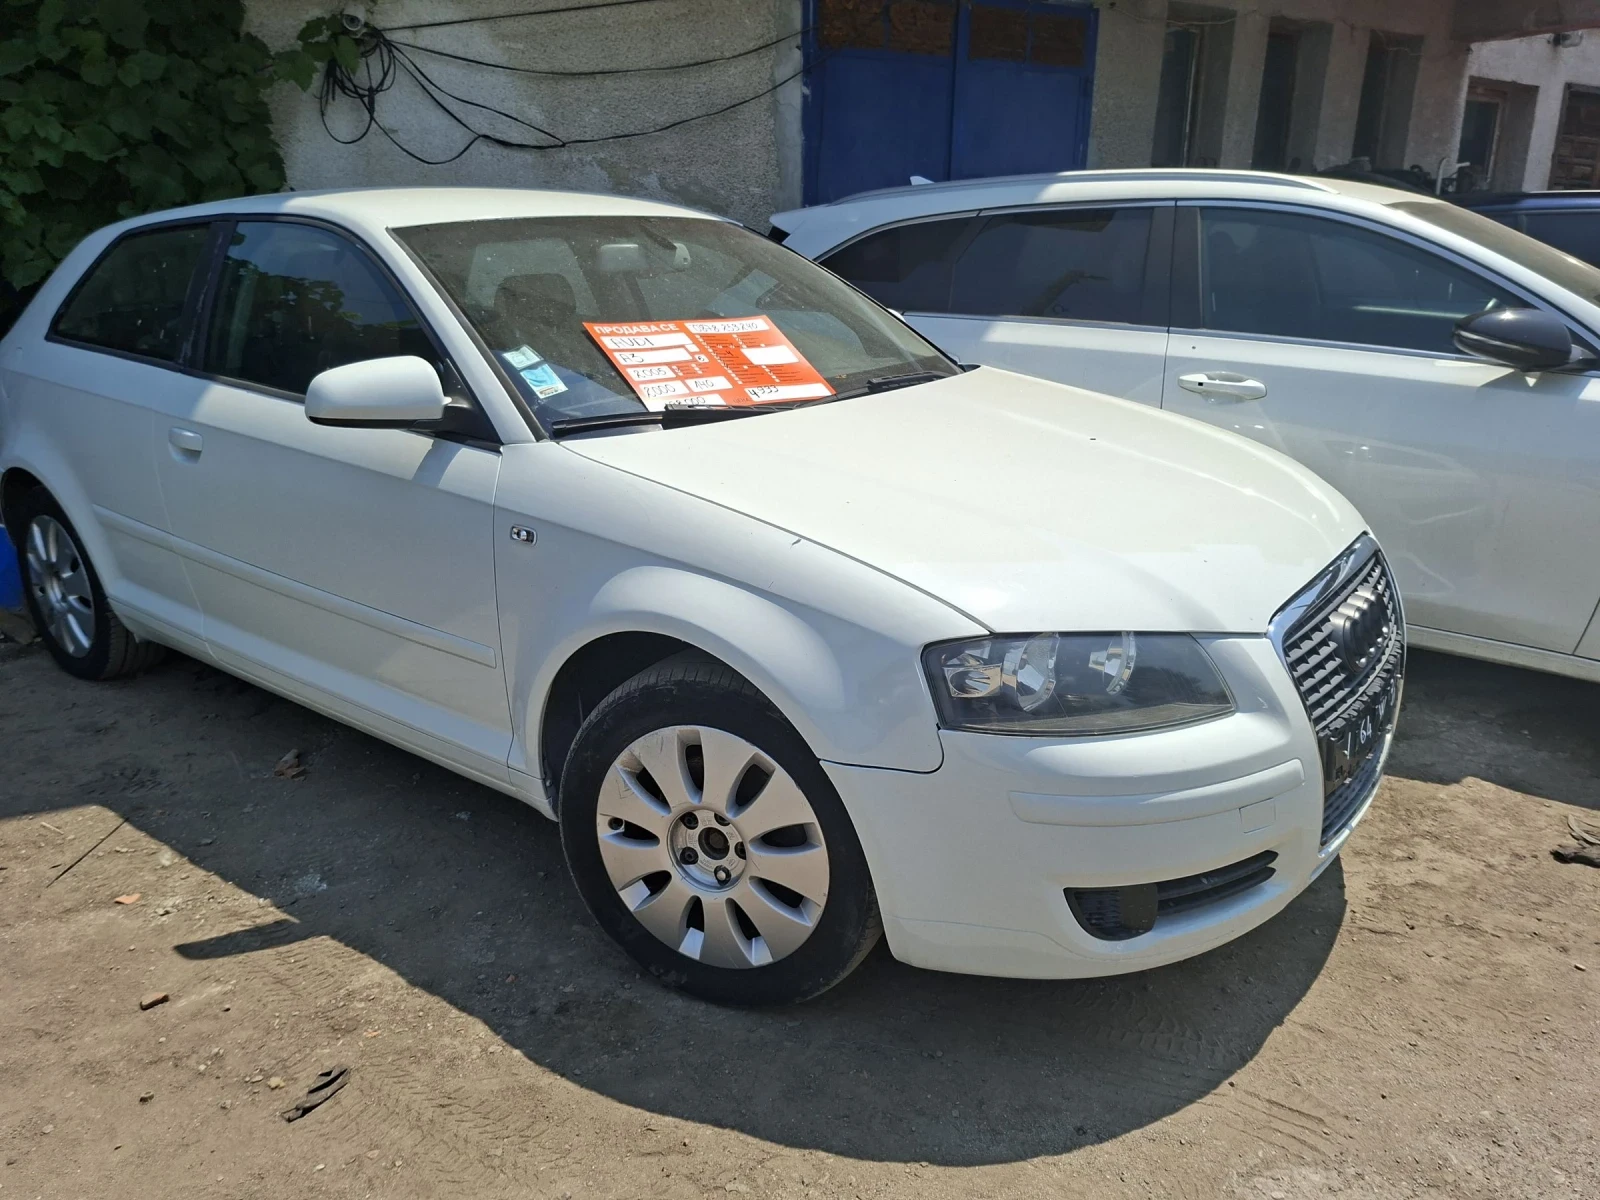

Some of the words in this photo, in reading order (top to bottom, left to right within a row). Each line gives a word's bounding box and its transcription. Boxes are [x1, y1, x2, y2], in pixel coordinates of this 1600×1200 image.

[593, 324, 660, 335] ПРОДАВА
[660, 323, 680, 331] СЕ
[610, 337, 655, 348] AUDI
[619, 353, 645, 363] A3
